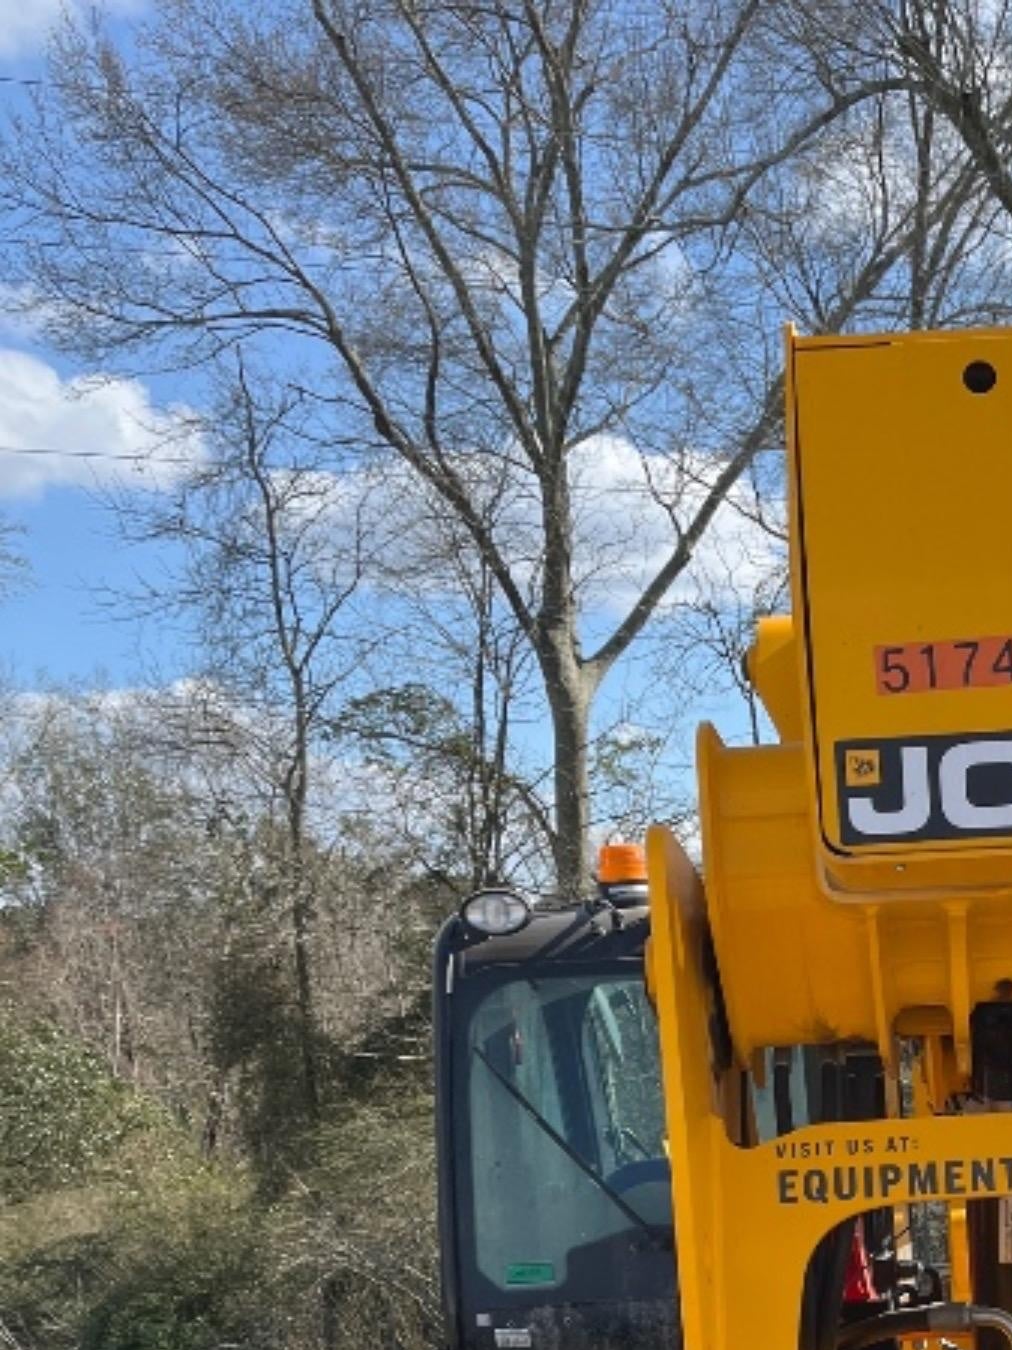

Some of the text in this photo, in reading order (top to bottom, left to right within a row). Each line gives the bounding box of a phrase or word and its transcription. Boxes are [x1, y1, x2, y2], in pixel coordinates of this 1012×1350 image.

[776, 1135, 919, 1160] VISIT US AT:
